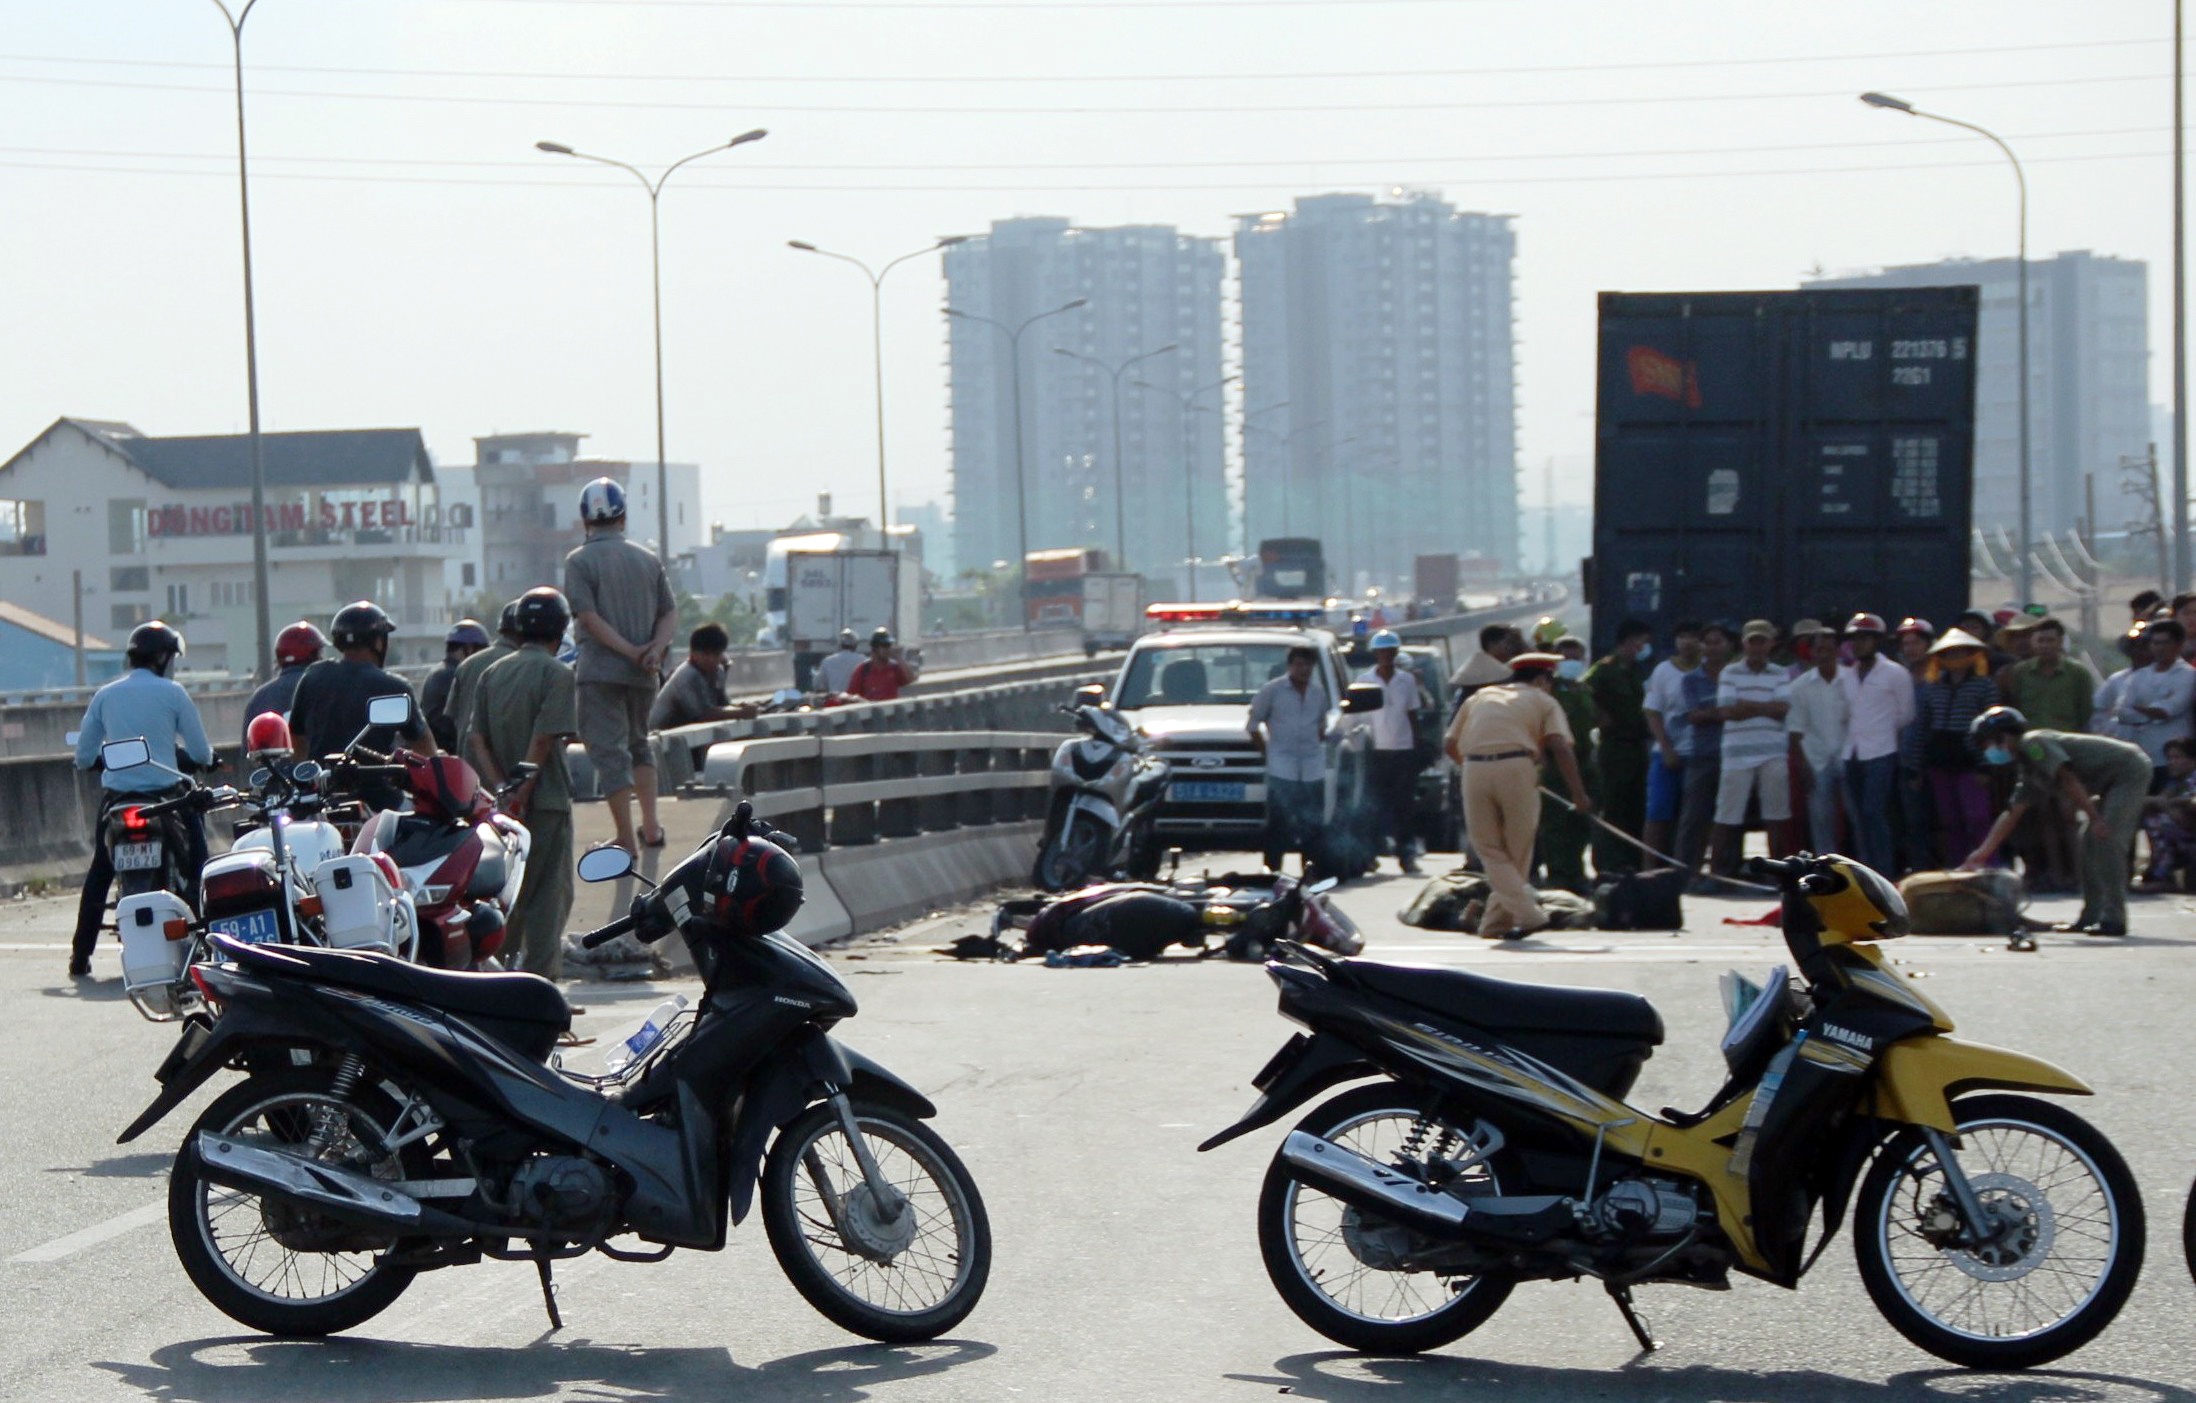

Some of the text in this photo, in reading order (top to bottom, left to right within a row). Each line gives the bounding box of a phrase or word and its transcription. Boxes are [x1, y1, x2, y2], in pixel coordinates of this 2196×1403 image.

[320, 499, 415, 531] STEEL
[220, 914, 266, 939] 59-A1
[774, 995, 811, 1009] HONDA
[1823, 1022, 1873, 1051] YAMAHA
